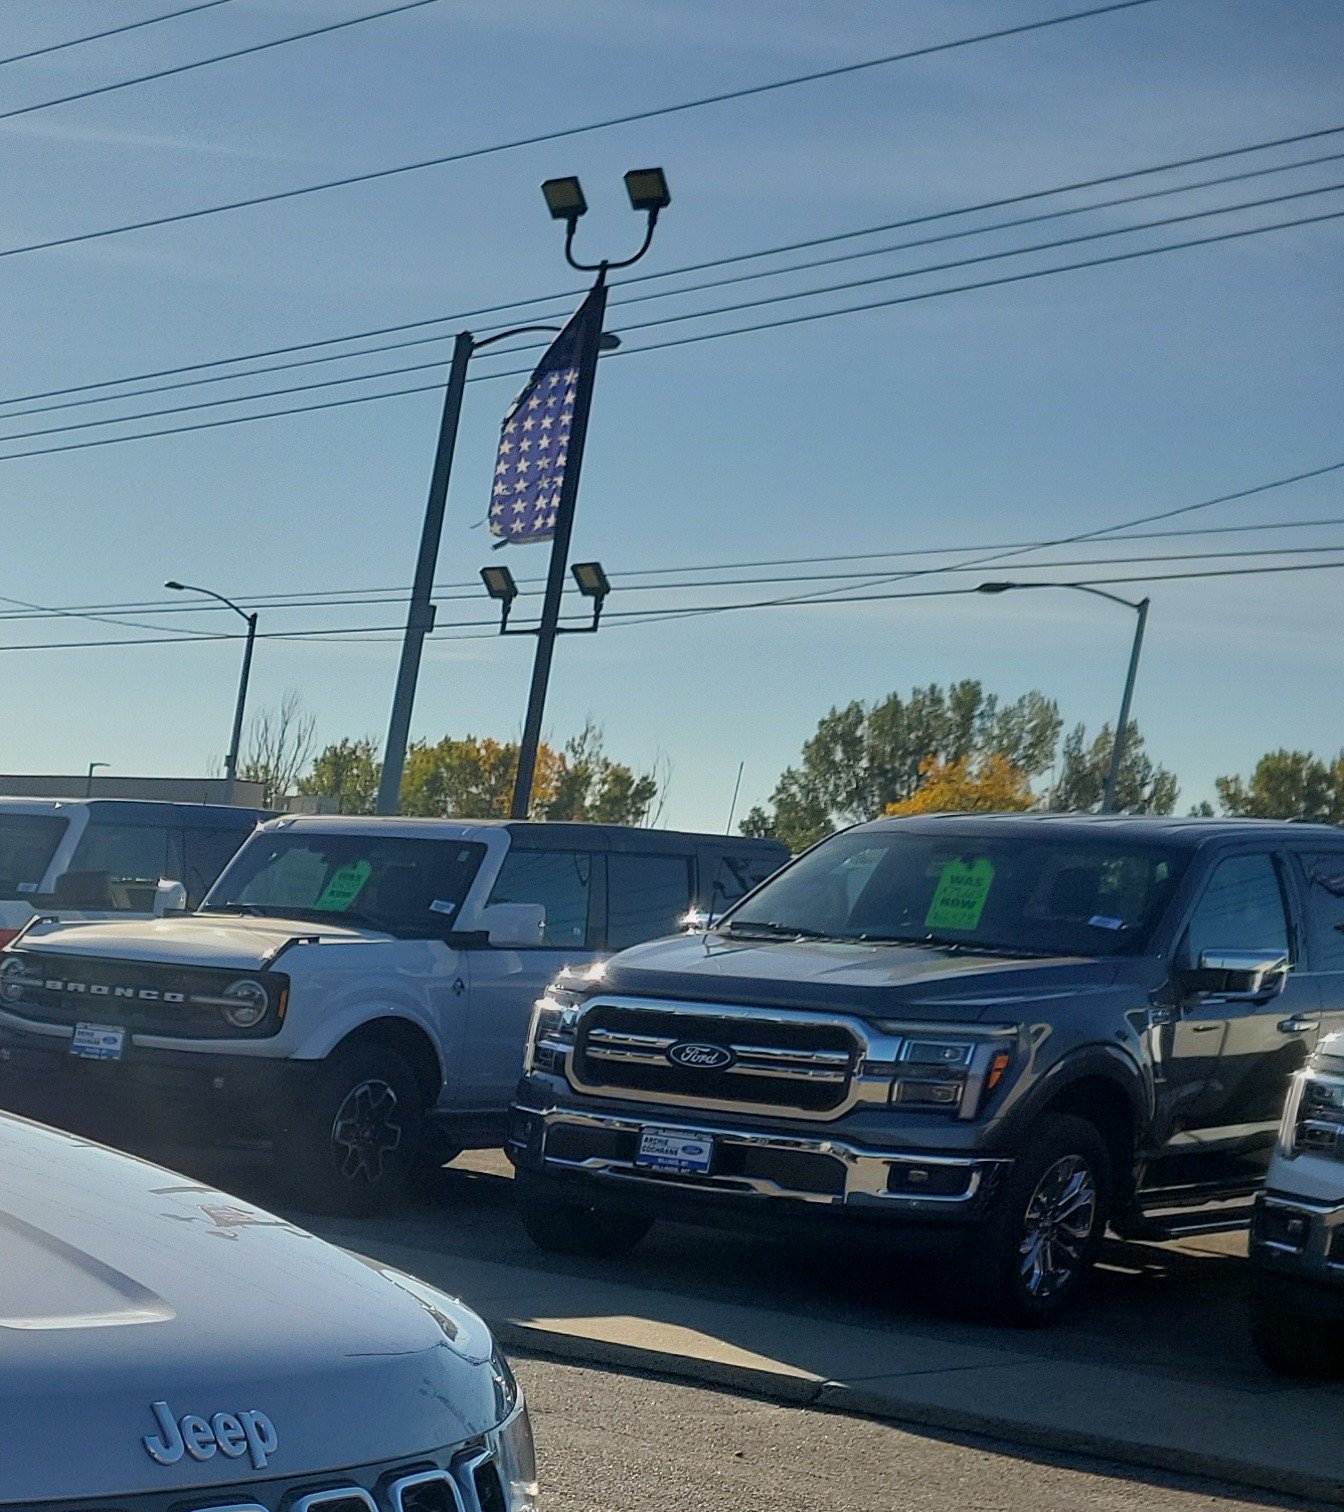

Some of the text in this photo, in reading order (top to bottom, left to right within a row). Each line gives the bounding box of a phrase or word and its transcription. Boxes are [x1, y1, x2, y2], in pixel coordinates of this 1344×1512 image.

[45, 979, 185, 1003] BRONCO
[680, 1046, 720, 1064] Ford
[142, 1401, 278, 1469] Jeep
